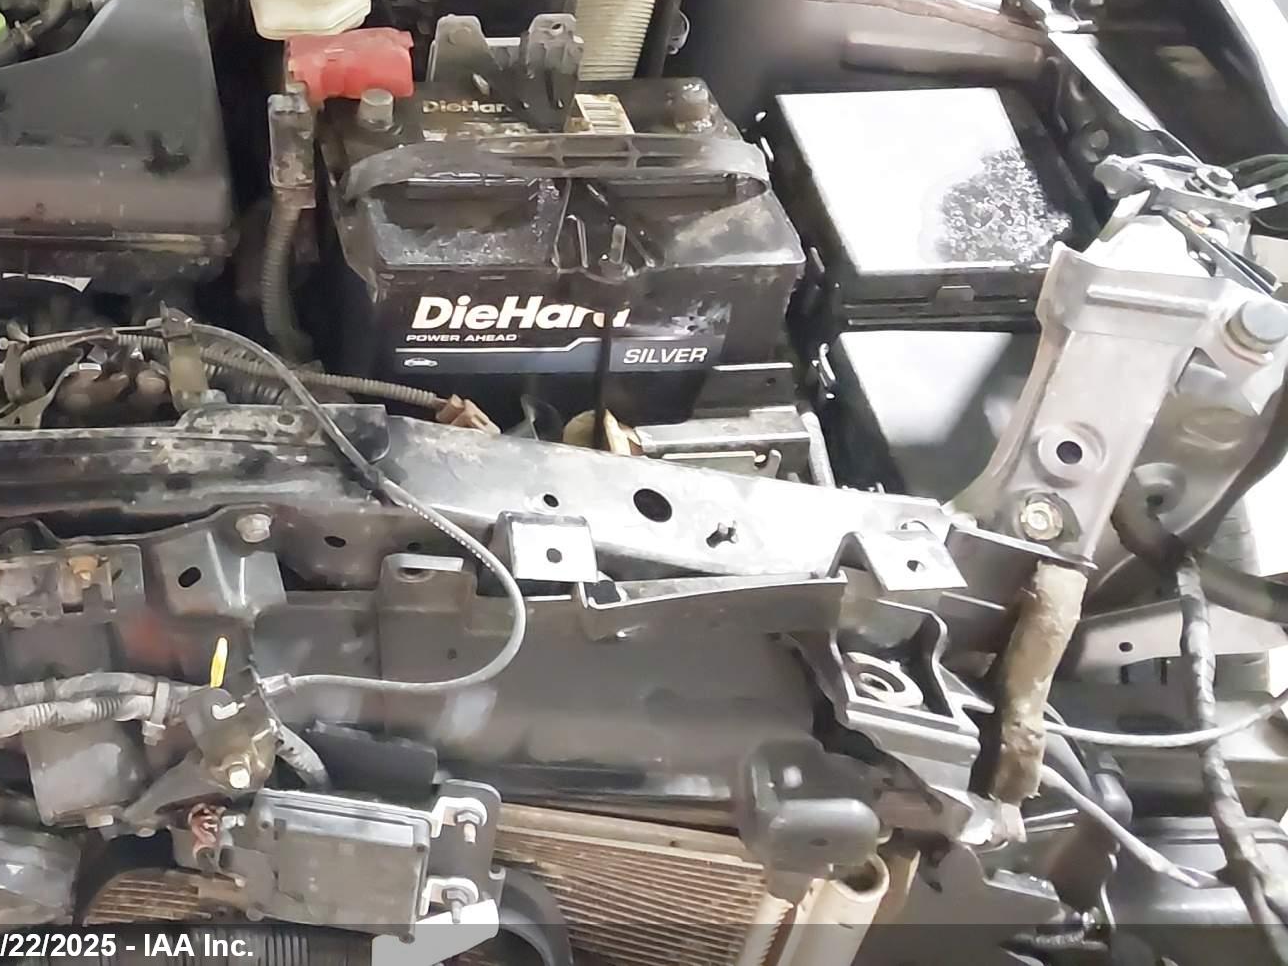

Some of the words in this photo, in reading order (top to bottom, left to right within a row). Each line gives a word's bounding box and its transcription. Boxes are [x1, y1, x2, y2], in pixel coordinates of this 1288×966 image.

[422, 100, 513, 113] DieHar
[406, 334, 461, 343] POWER
[464, 333, 518, 343] AHEAD
[623, 347, 709, 365] SILVER
